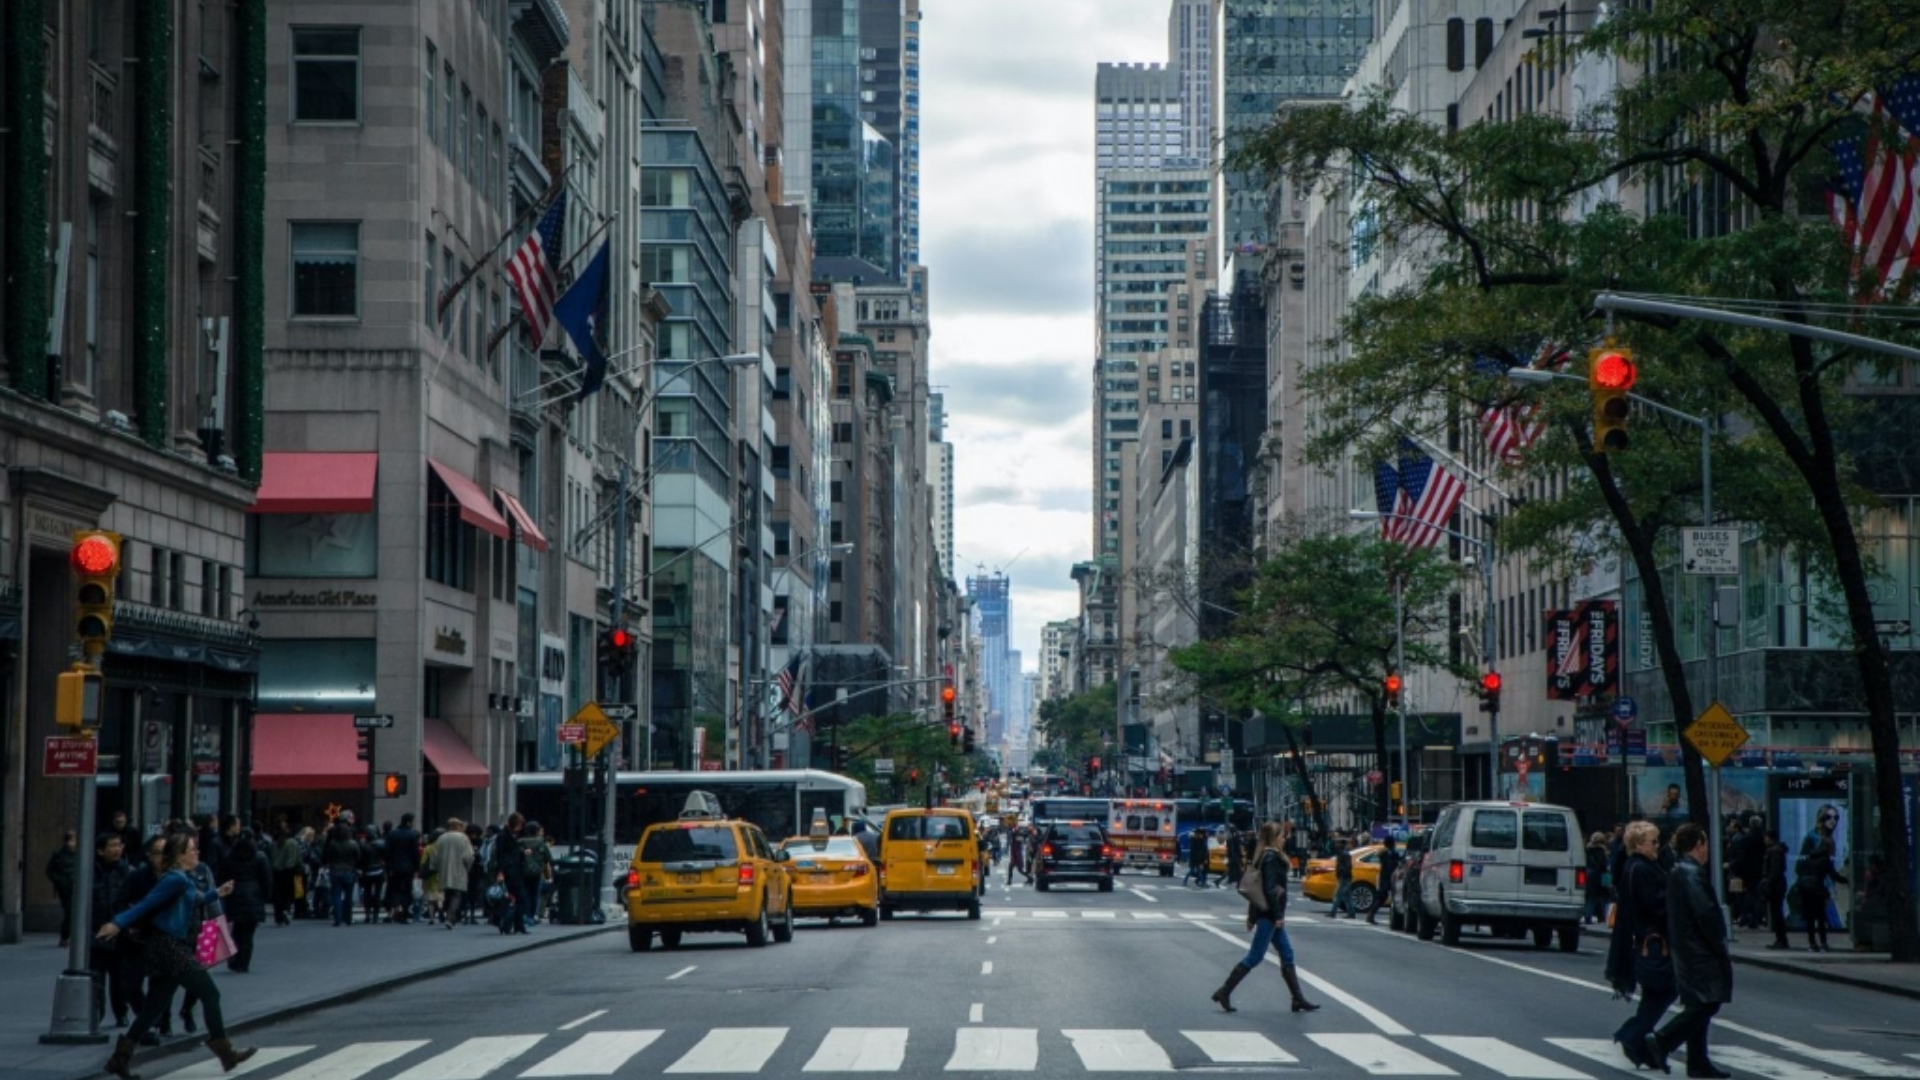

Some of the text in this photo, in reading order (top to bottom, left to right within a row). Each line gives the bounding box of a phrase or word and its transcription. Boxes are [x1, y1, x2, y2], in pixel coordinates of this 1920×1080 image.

[1692, 531, 1730, 541] BUSES
[1696, 548, 1726, 558] ONLY
[317, 589, 341, 606] Girl
[342, 589, 378, 606] Place
[1773, 584, 1898, 604] TOPOP
[1557, 629, 1570, 689] FRIDS
[1590, 620, 1605, 684] FRIDAYS
[53, 751, 89, 761] ANYTIME
